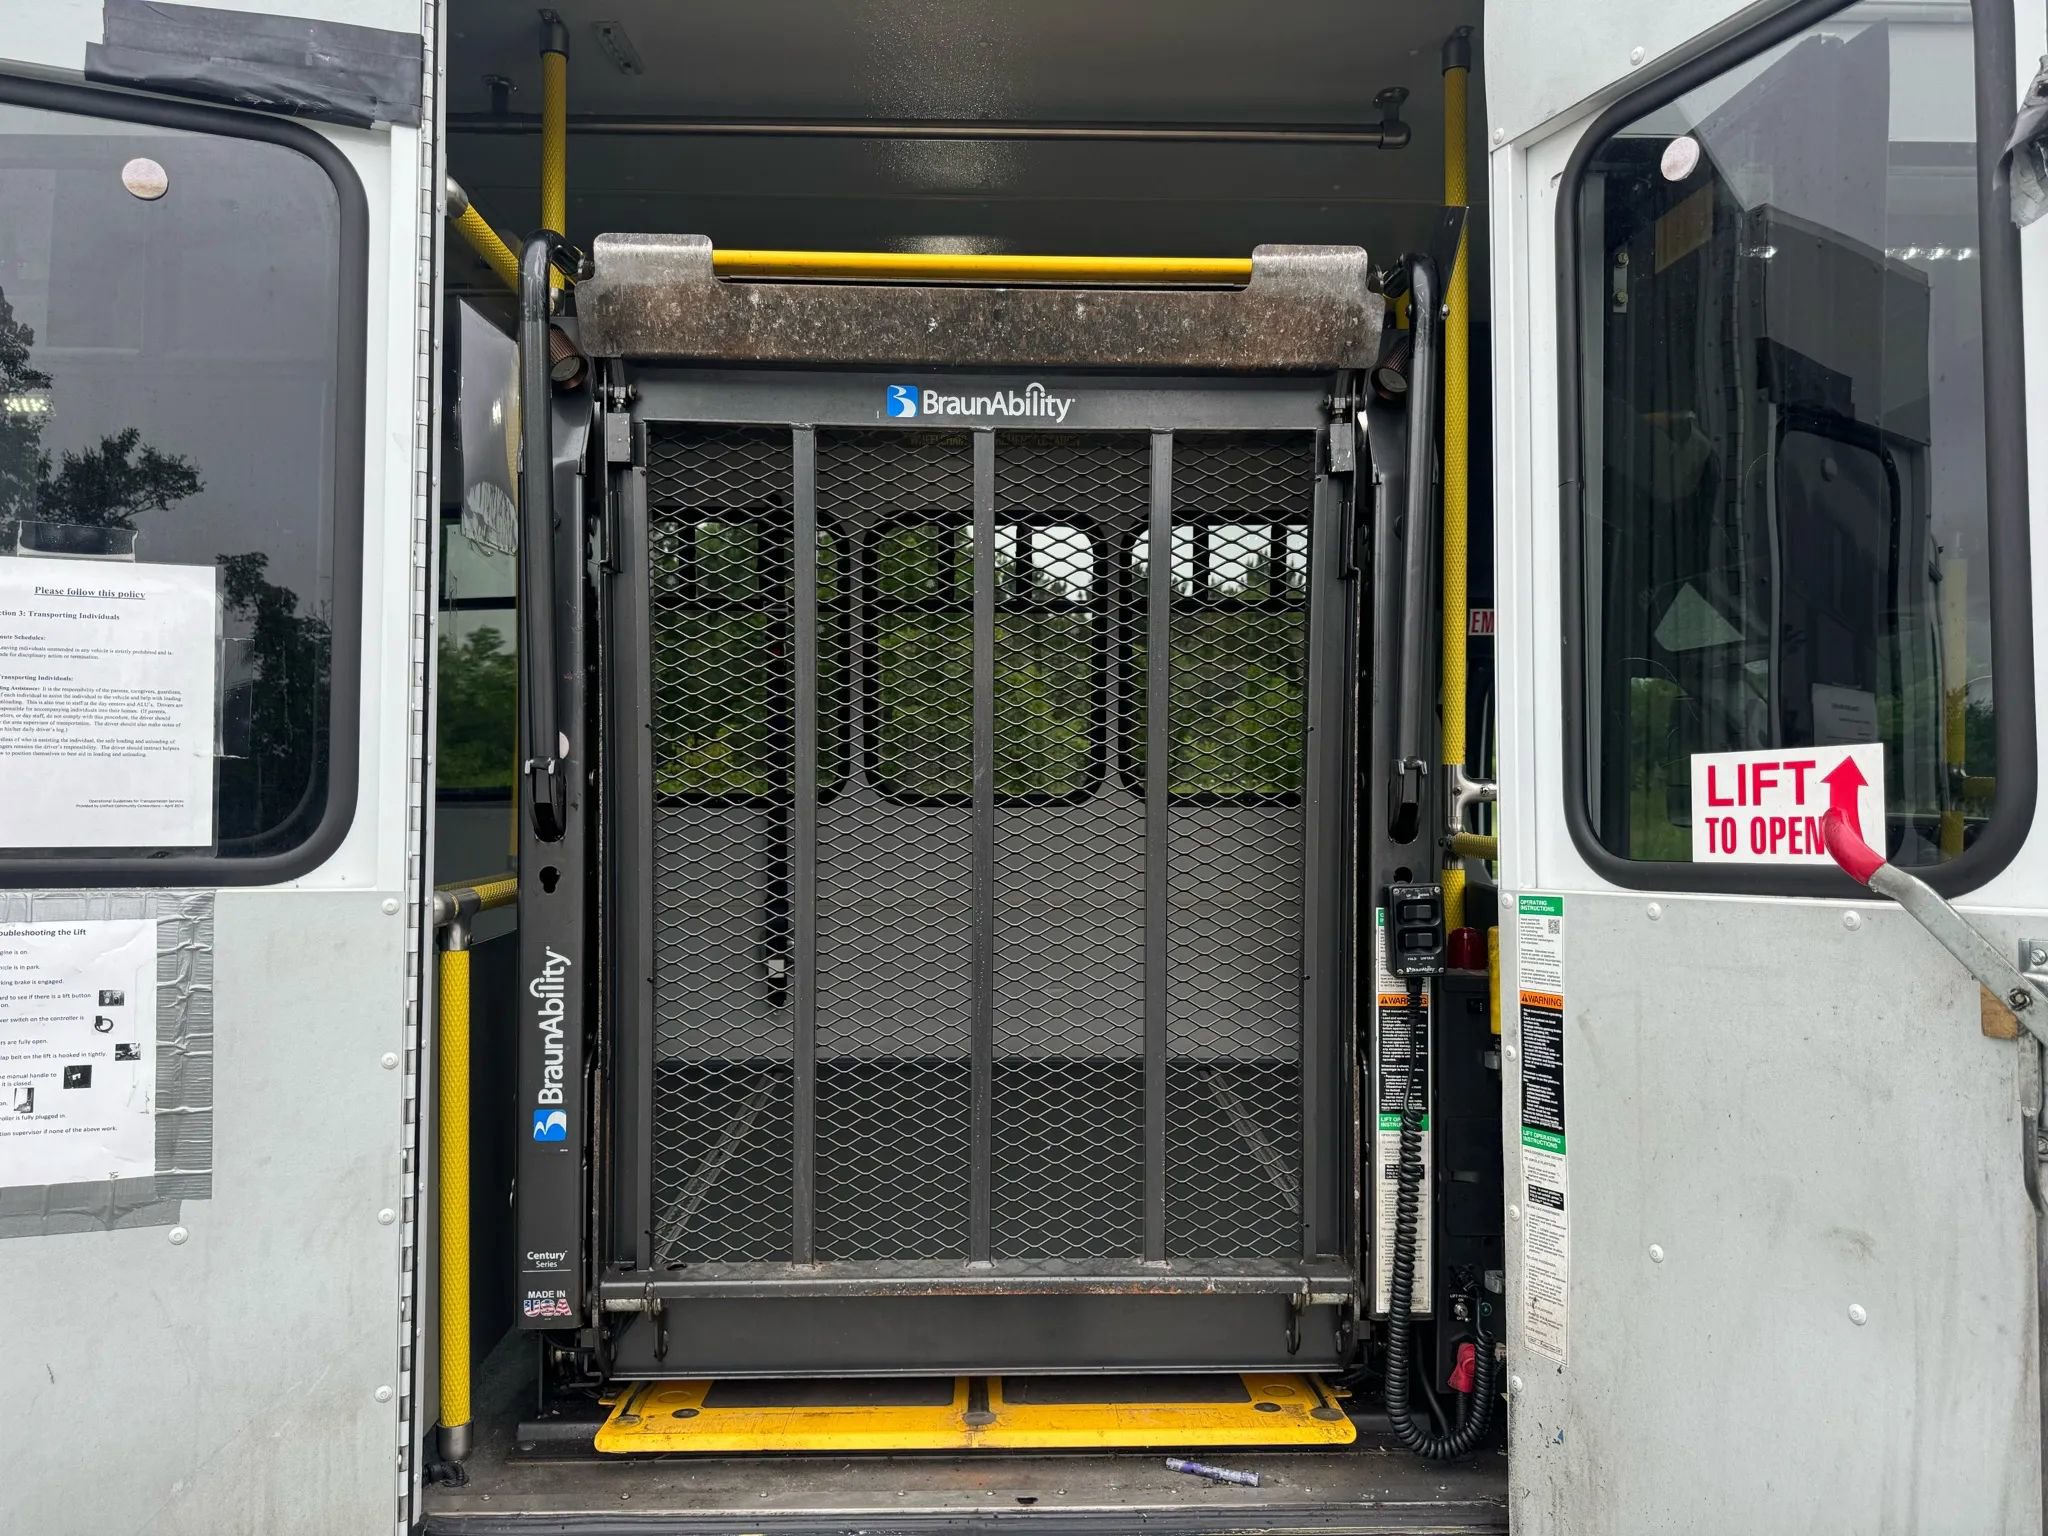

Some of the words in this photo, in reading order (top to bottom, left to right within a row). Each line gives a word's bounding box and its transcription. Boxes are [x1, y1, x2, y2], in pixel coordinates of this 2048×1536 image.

[923, 382, 1071, 423] BraunAbility
[35, 586, 64, 595] Please
[67, 587, 96, 597] follow
[98, 588, 116, 598] this
[118, 591, 146, 600] policy
[28, 610, 77, 620] Transporting
[79, 612, 120, 621] Individuals
[0, 674, 37, 682] ransporting
[1707, 760, 1816, 807] LIFT
[1705, 817, 1737, 854] TO
[1750, 816, 1825, 855] OPEN
[1520, 899, 1549, 907] OPERATING
[1520, 904, 1556, 913] INSTRUCTIONS
[1388, 997, 1428, 1005] WARG
[1528, 995, 1562, 1007] WARNING
[529, 952, 571, 1104] BraunAbility
[35, 1114, 58, 1122] plugged
[12, 1130, 42, 1138] supervisor
[1523, 1130, 1533, 1138] LIFT
[1534, 1132, 1562, 1145] OPERATING
[1523, 1136, 1559, 1150] INSTRUCTIONS
[527, 1251, 566, 1262] Century
[528, 1290, 555, 1299] MADE
[556, 1290, 566, 1298] IN
[523, 1298, 574, 1318] USA
